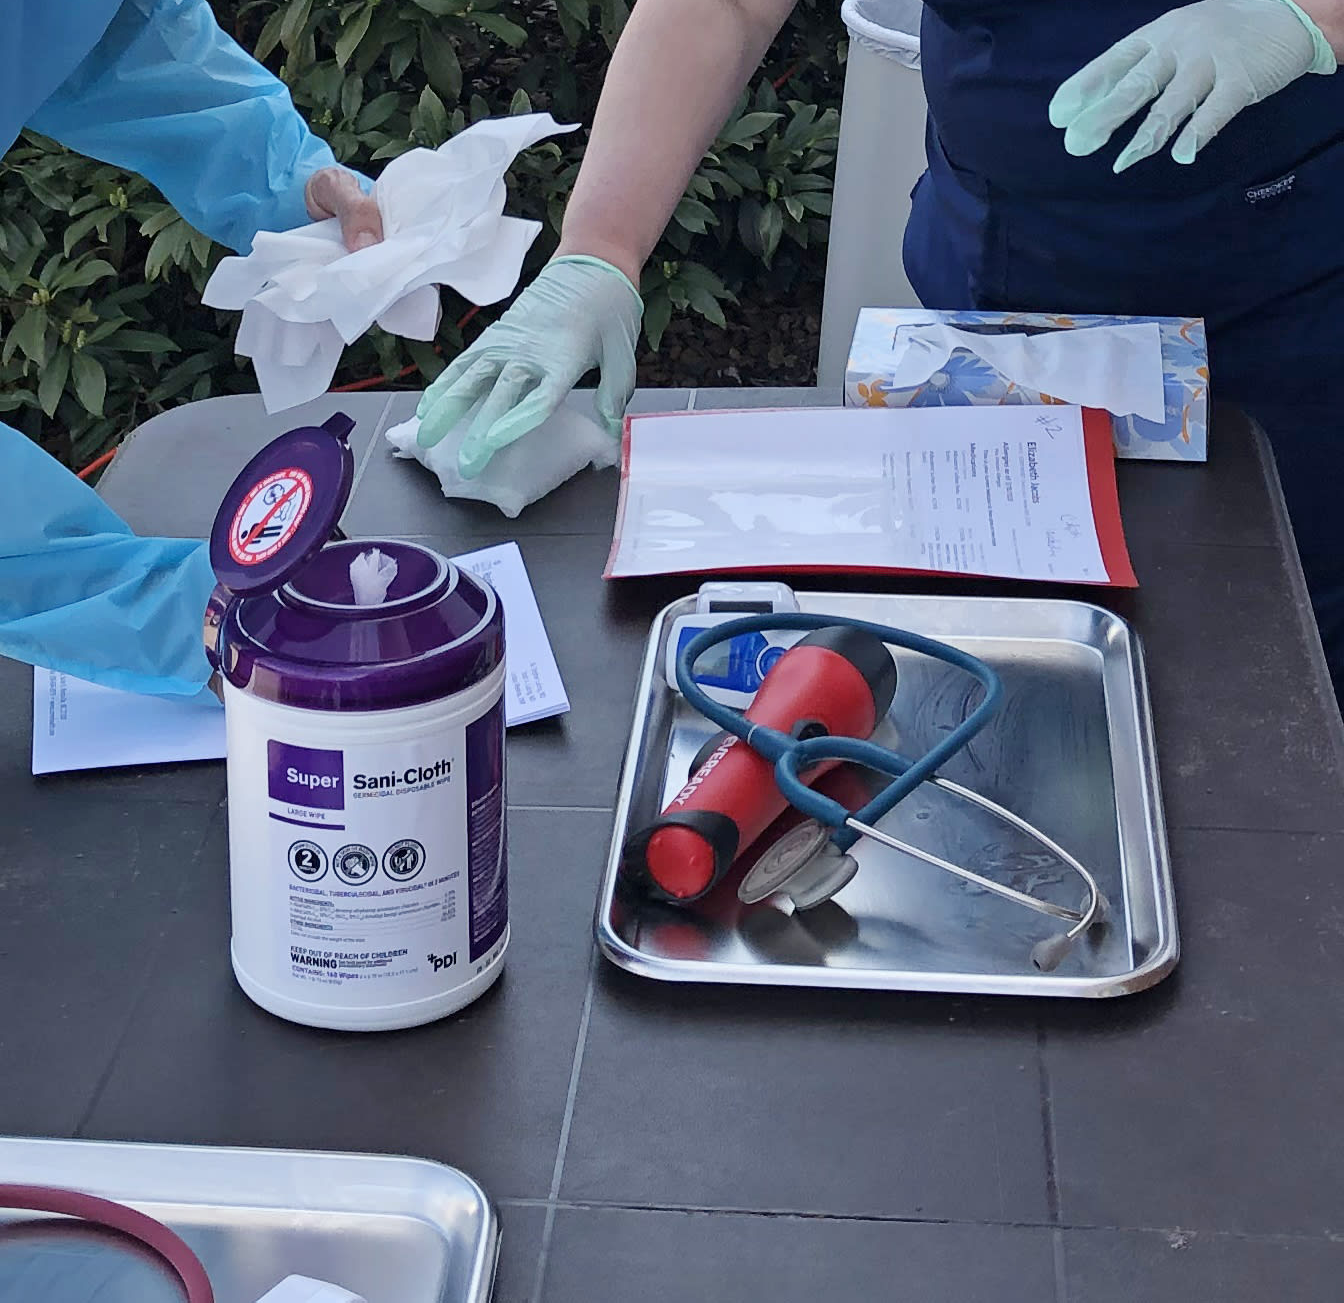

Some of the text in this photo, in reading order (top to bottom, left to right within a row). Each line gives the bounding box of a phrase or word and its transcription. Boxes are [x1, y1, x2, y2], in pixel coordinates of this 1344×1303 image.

[1027, 441, 1039, 480] Elizabeth
[286, 759, 452, 790] Super Sani-Cloth
[674, 735, 738, 806] EVEREADY
[308, 810, 326, 820] WIPE
[302, 850, 313, 867] 2
[290, 945, 308, 954] KEEP
[308, 949, 322, 957] OUT
[323, 951, 333, 959] OF
[290, 952, 337, 969] WARNING
